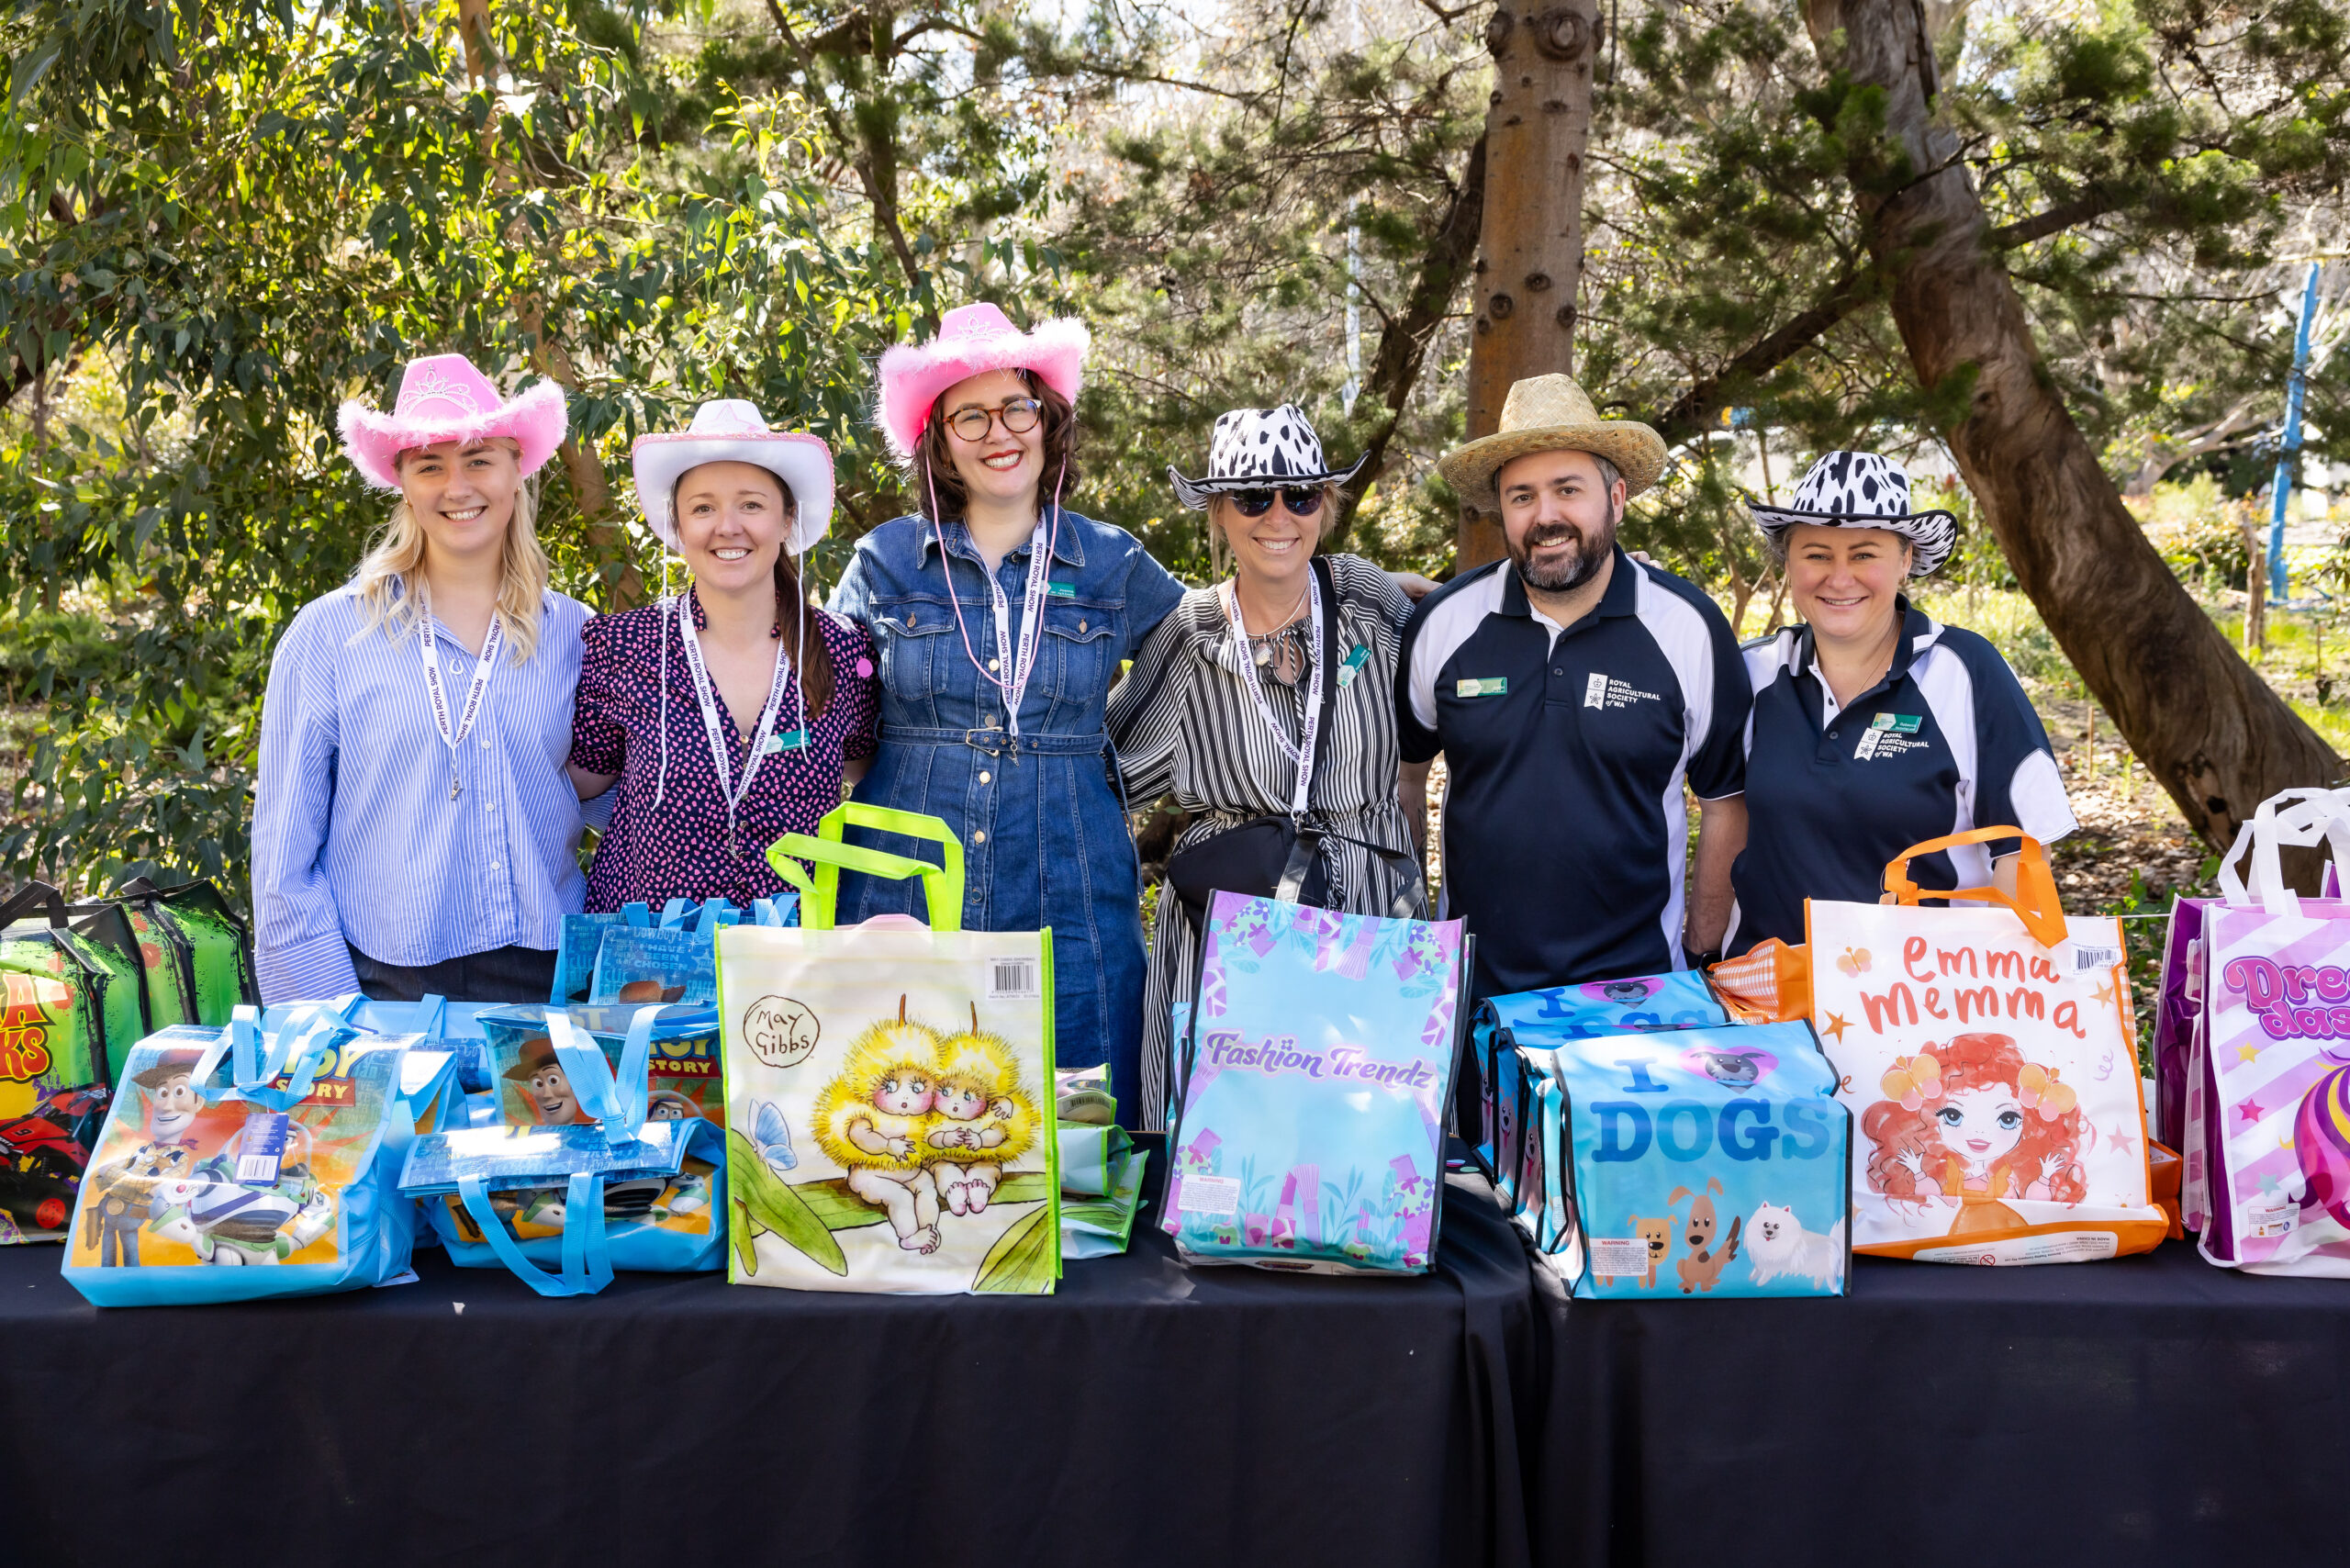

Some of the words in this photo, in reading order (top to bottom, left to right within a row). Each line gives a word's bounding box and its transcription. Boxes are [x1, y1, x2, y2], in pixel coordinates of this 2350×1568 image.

[1032, 566, 1040, 588] ROYAL
[996, 586, 1005, 608] PERTH
[488, 623, 501, 644] ROYAL
[1000, 631, 1008, 654] SHOW
[1021, 633, 1030, 656] PERTH
[483, 644, 494, 663] SHOW
[1239, 641, 1248, 661] SHOW
[428, 666, 439, 687] SHOW
[688, 640, 698, 662] PERTH
[694, 662, 705, 685] ROYAL
[700, 686, 711, 707] SHOW
[1017, 657, 1026, 681] ROYAL
[1244, 661, 1253, 682] ROYAL
[472, 678, 483, 699] PERTH
[769, 689, 780, 711] PERTH
[776, 666, 784, 689] ROYAL
[1013, 683, 1022, 705] HOW
[1250, 682, 1262, 705] PERTH
[1608, 687, 1661, 700] AGRICULTURAL
[1609, 679, 1631, 689] ROYAL
[432, 687, 444, 711] ROYAL
[1606, 692, 1638, 703] SOCIETY
[464, 699, 477, 722] ROYAL
[439, 711, 448, 734] PERTH
[1270, 722, 1285, 744] SHOW
[1306, 716, 1315, 740] PERTH
[455, 723, 468, 745] SHOW
[1880, 738, 1930, 747] AGRICULTURAL
[711, 728, 722, 751] PERTH
[717, 751, 727, 775] ROYAL
[747, 754, 759, 777] ROYAL
[755, 730, 767, 753] SHOW
[1283, 742, 1300, 760] ROYAL
[1300, 764, 1309, 786] SHOW
[643, 953, 679, 962] BEEN
[2223, 956, 2350, 1014] Dre
[1528, 986, 1576, 1019] I
[757, 1009, 803, 1037] May
[648, 1038, 711, 1059] OY
[755, 1030, 811, 1055] Gibbs
[283, 1045, 371, 1079] OY
[1206, 1031, 1325, 1079] Fashion
[1330, 1047, 1436, 1090] Trendz
[1613, 1057, 1670, 1093] I
[275, 1079, 349, 1100] SORY
[1590, 1098, 1830, 1163] DOGS
